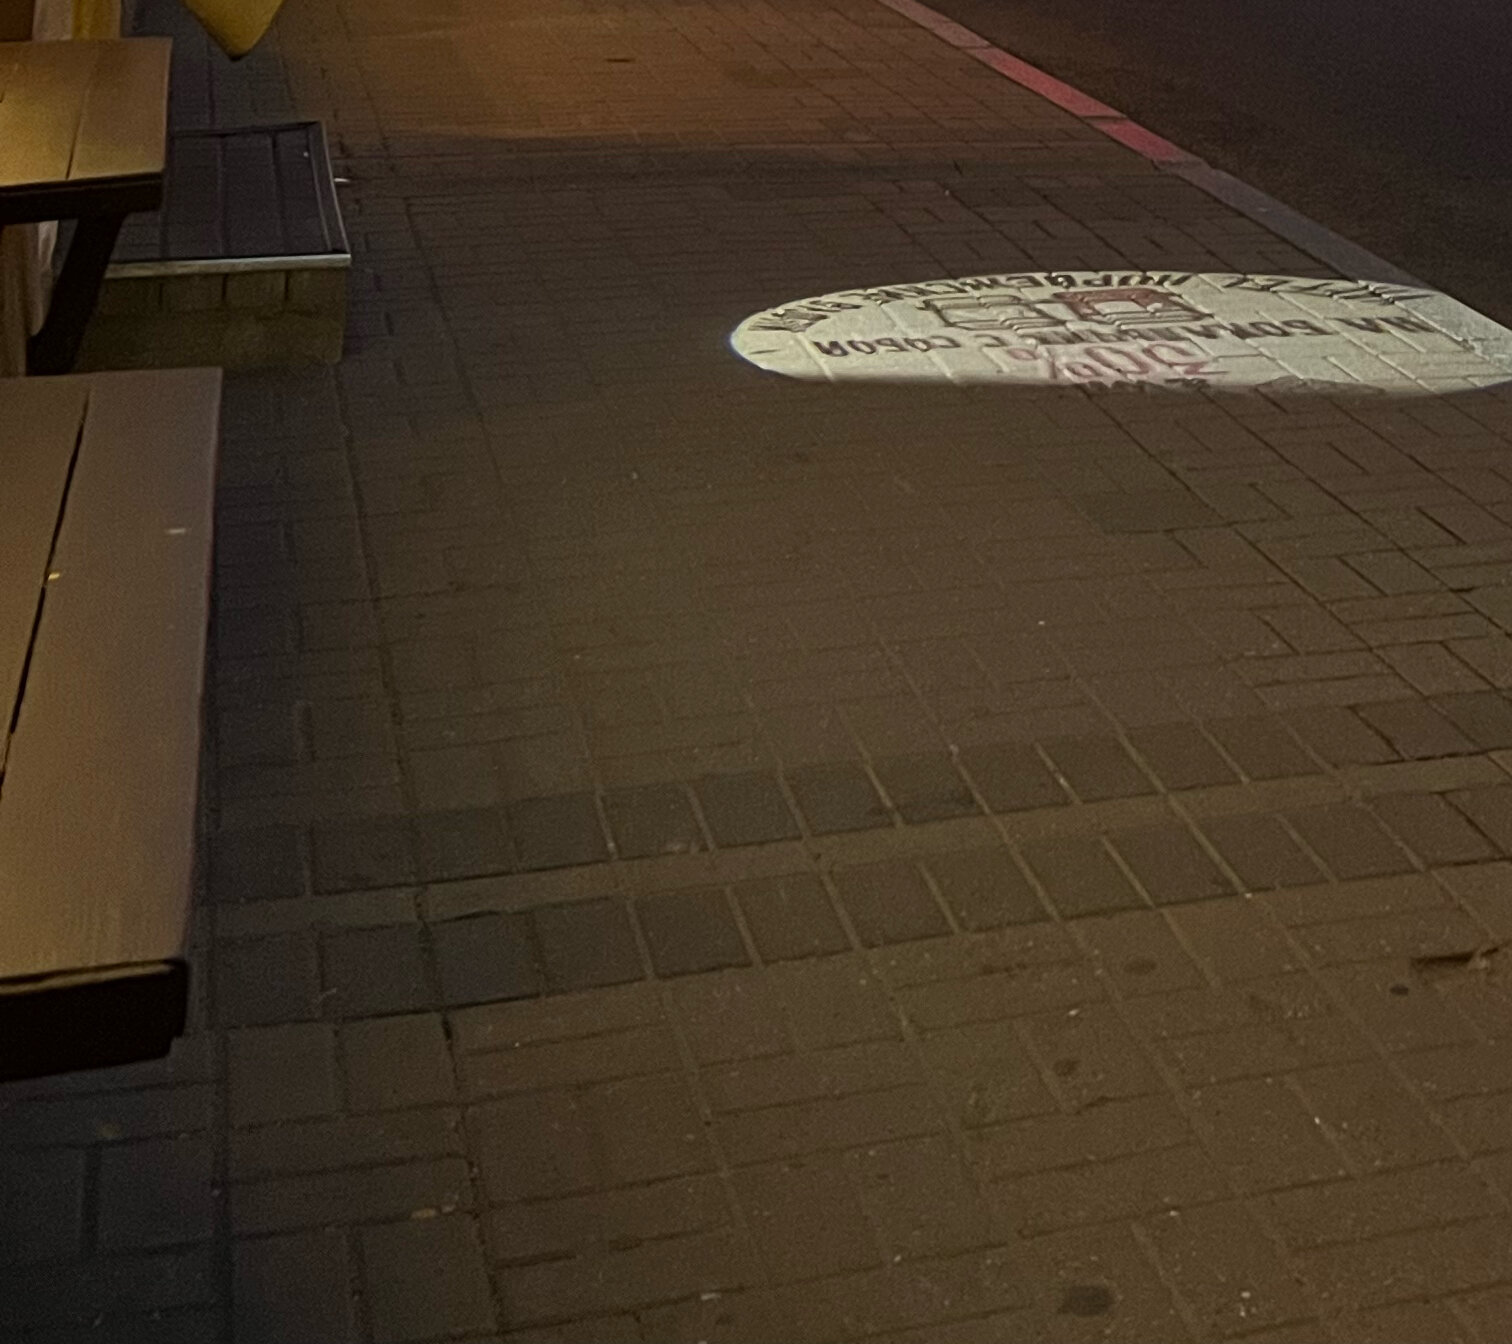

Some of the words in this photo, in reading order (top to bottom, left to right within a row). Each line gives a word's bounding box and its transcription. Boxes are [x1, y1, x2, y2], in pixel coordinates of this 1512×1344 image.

[1331, 317, 1437, 334] НА
[974, 333, 1009, 348] С
[1006, 343, 1229, 381] 30%
